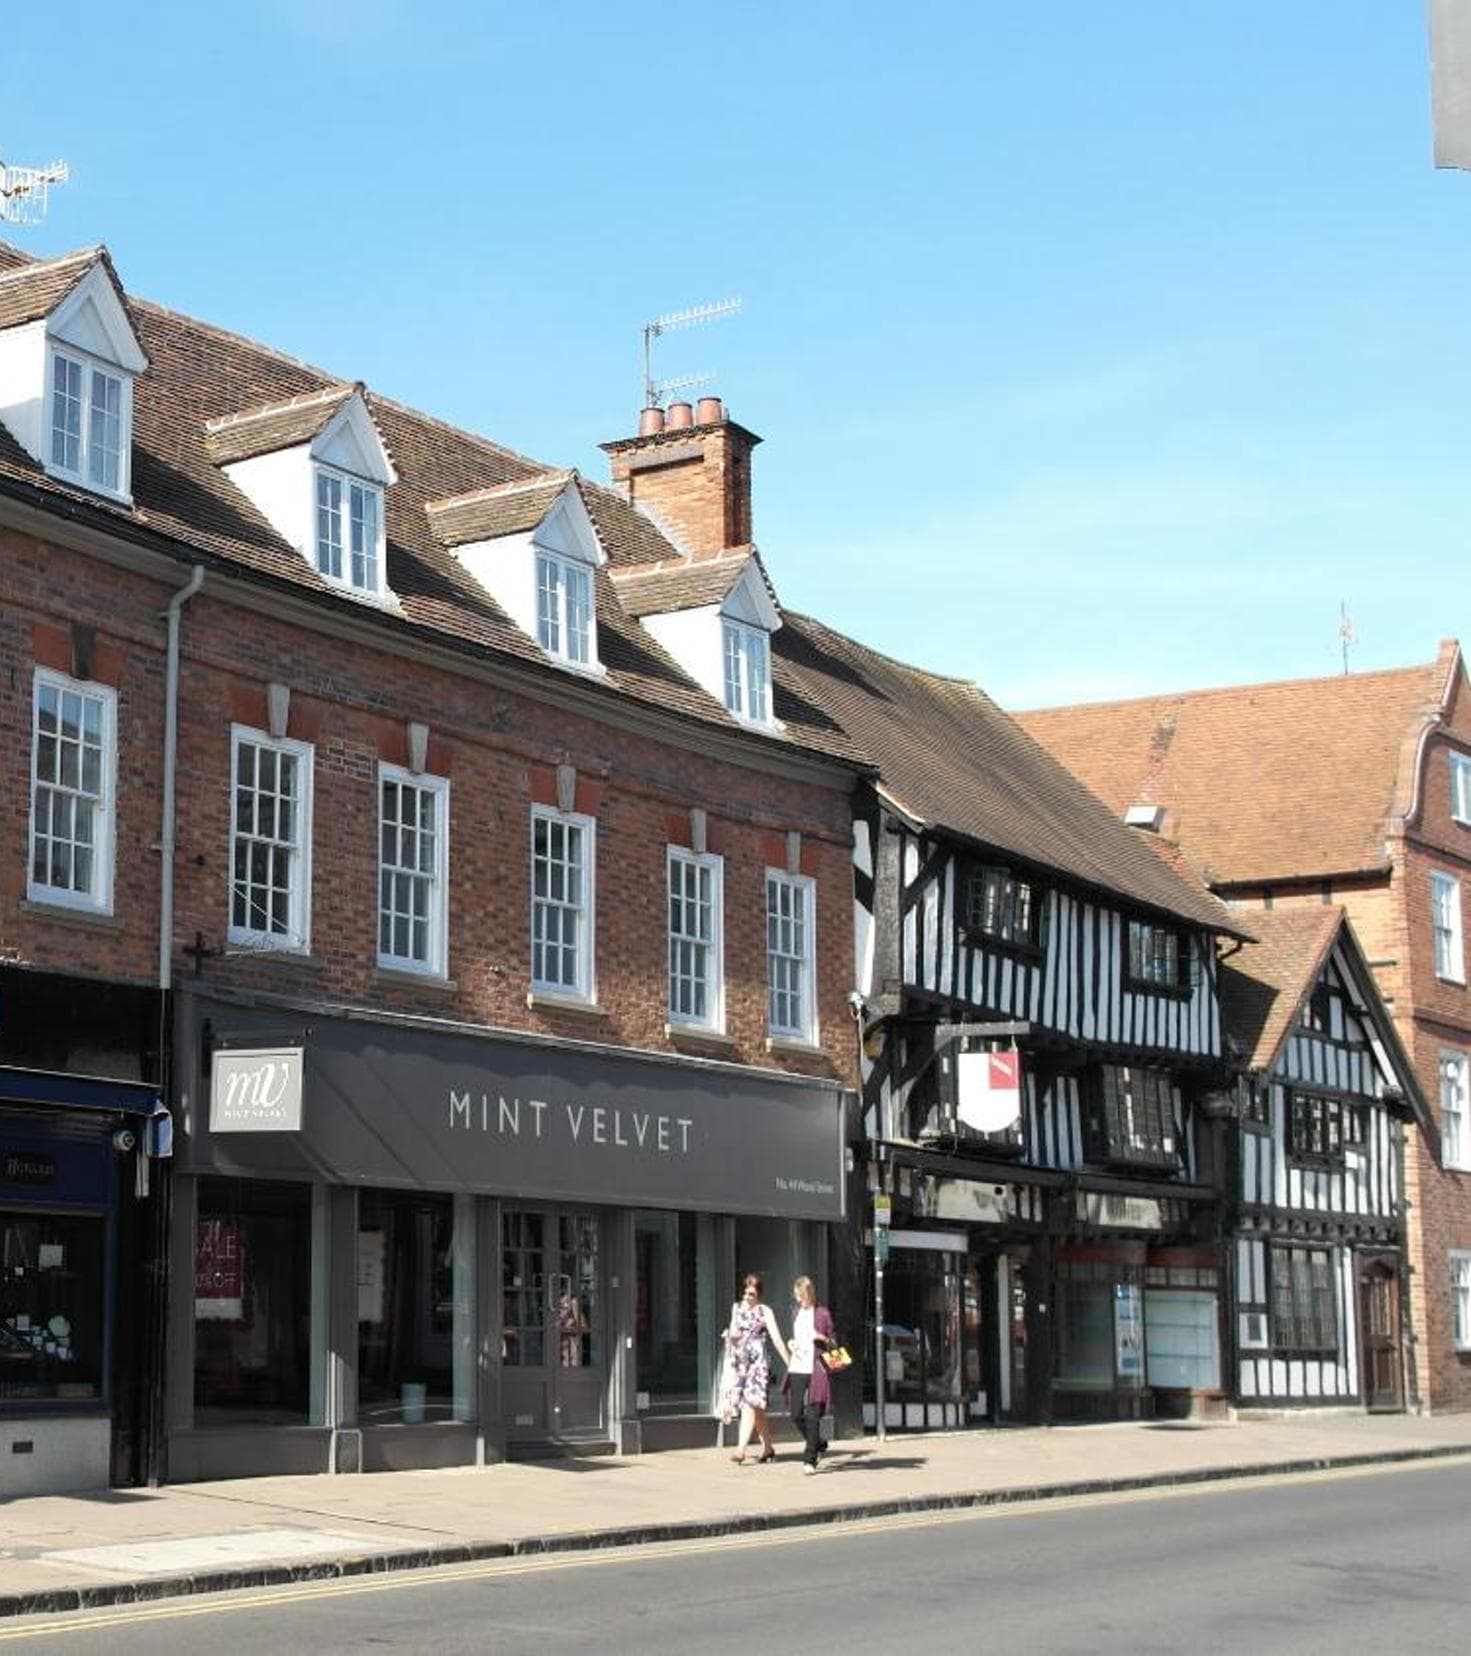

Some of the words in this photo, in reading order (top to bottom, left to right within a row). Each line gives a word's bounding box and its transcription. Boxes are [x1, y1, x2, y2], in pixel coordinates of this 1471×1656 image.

[449, 1089, 547, 1137] MINT
[566, 1104, 693, 1153] VELVET
[195, 1235, 237, 1259] ALE
